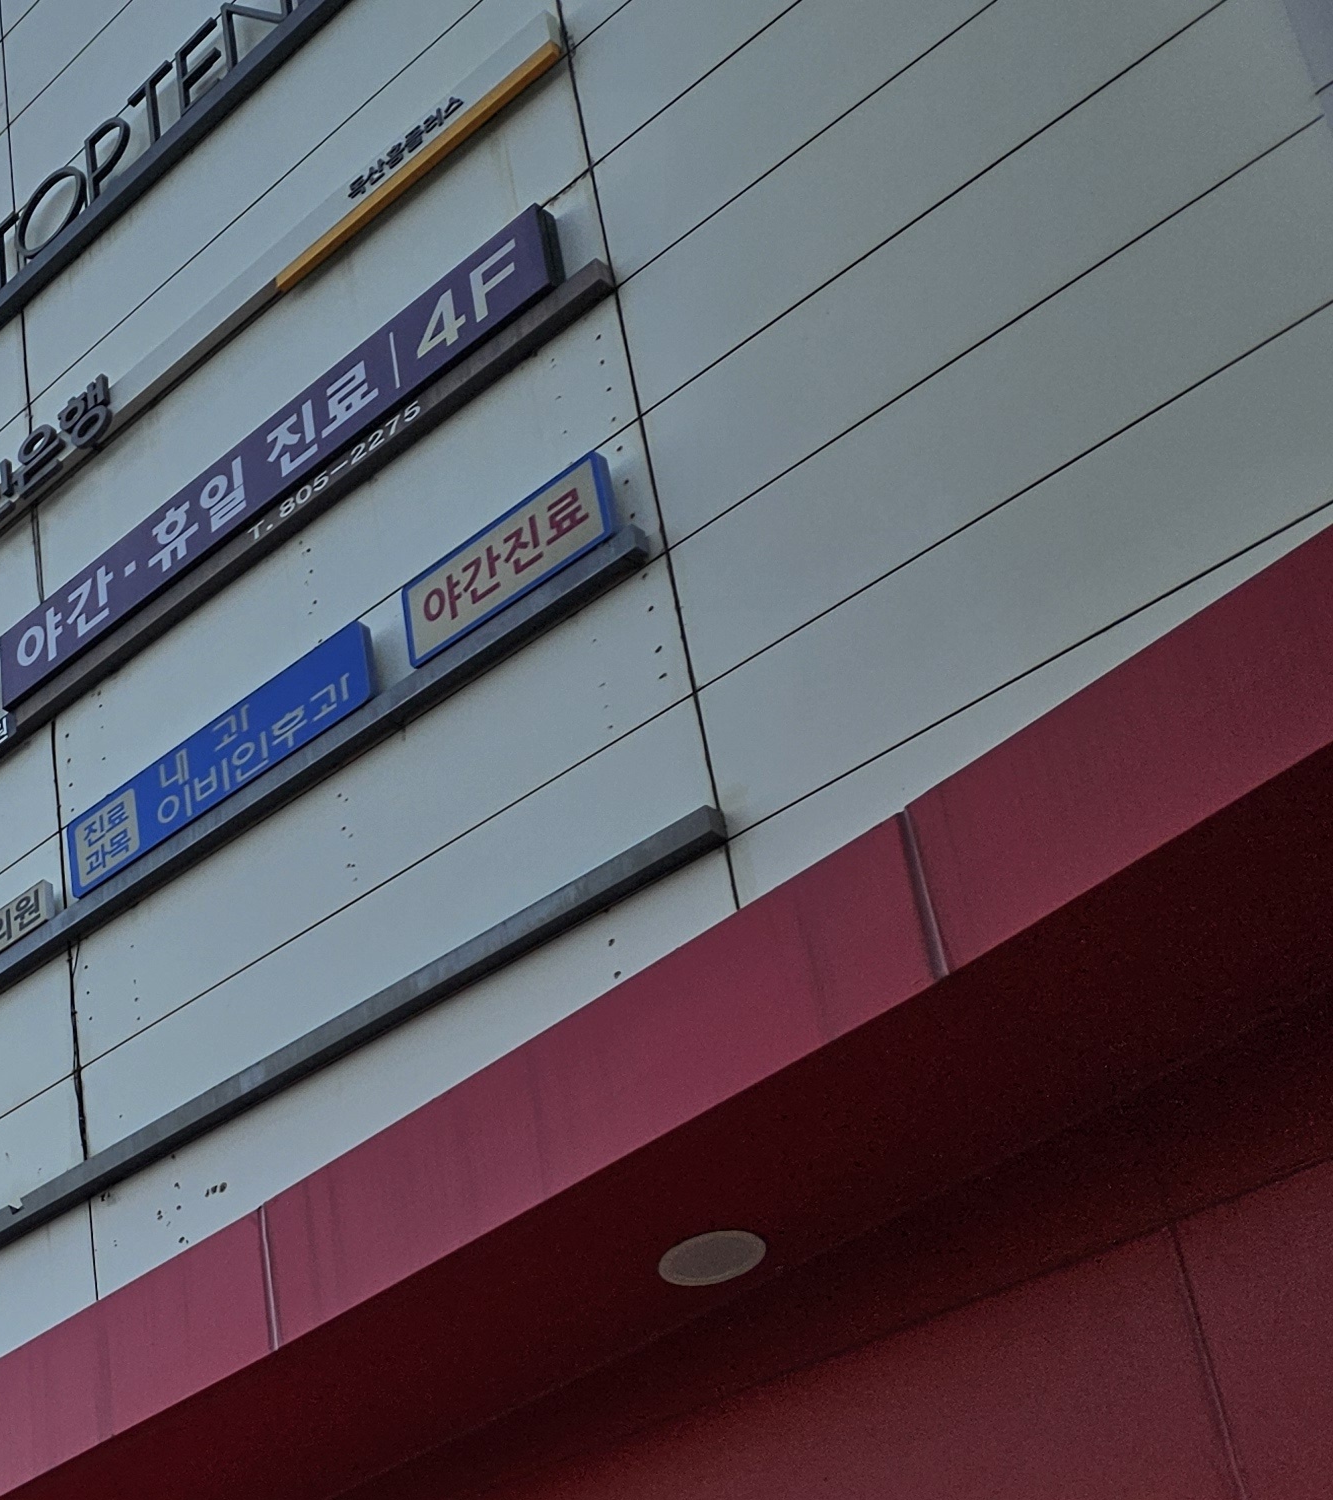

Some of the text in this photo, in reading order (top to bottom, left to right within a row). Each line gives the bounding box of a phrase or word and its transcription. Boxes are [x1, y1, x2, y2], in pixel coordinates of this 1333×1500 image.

[267, 360, 379, 478] 진료
[416, 238, 516, 360] 4F
[279, 400, 422, 519] 805-2275
[423, 487, 589, 623] 야간진료
[156, 672, 351, 826] 이비인후과
[83, 800, 130, 848] 진료
[85, 832, 133, 876] 과목
